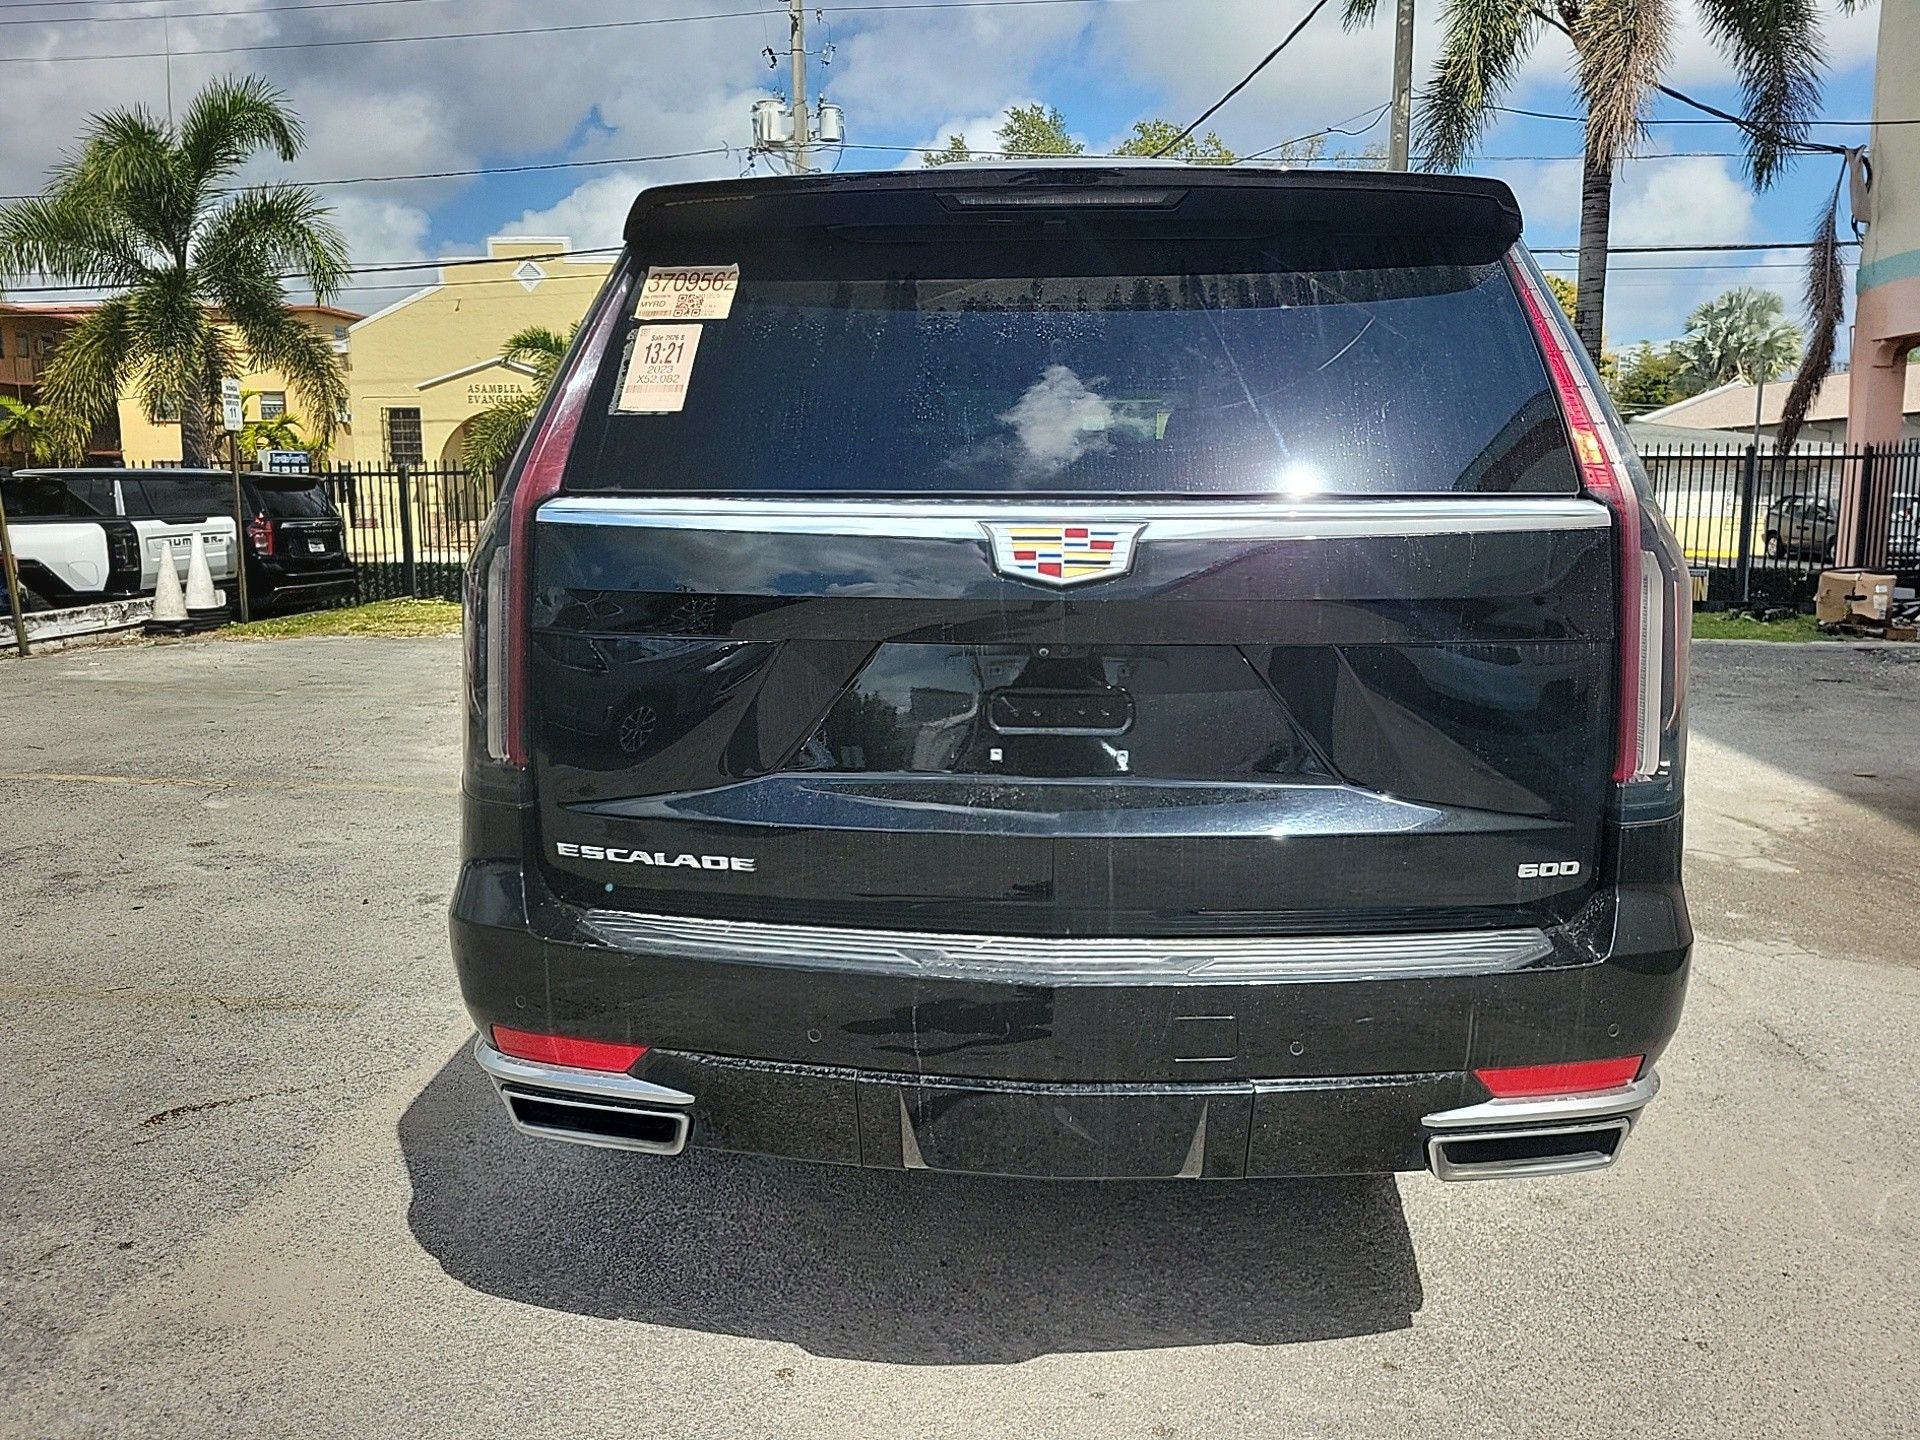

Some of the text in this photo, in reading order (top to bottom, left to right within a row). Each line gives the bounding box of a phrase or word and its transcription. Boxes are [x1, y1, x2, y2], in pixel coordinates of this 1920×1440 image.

[644, 342, 684, 364] 13:21
[647, 365, 674, 374] 2023
[467, 384, 523, 394] ASAMBLEA
[556, 842, 757, 872] ESCALADE
[1517, 861, 1580, 878] 600
